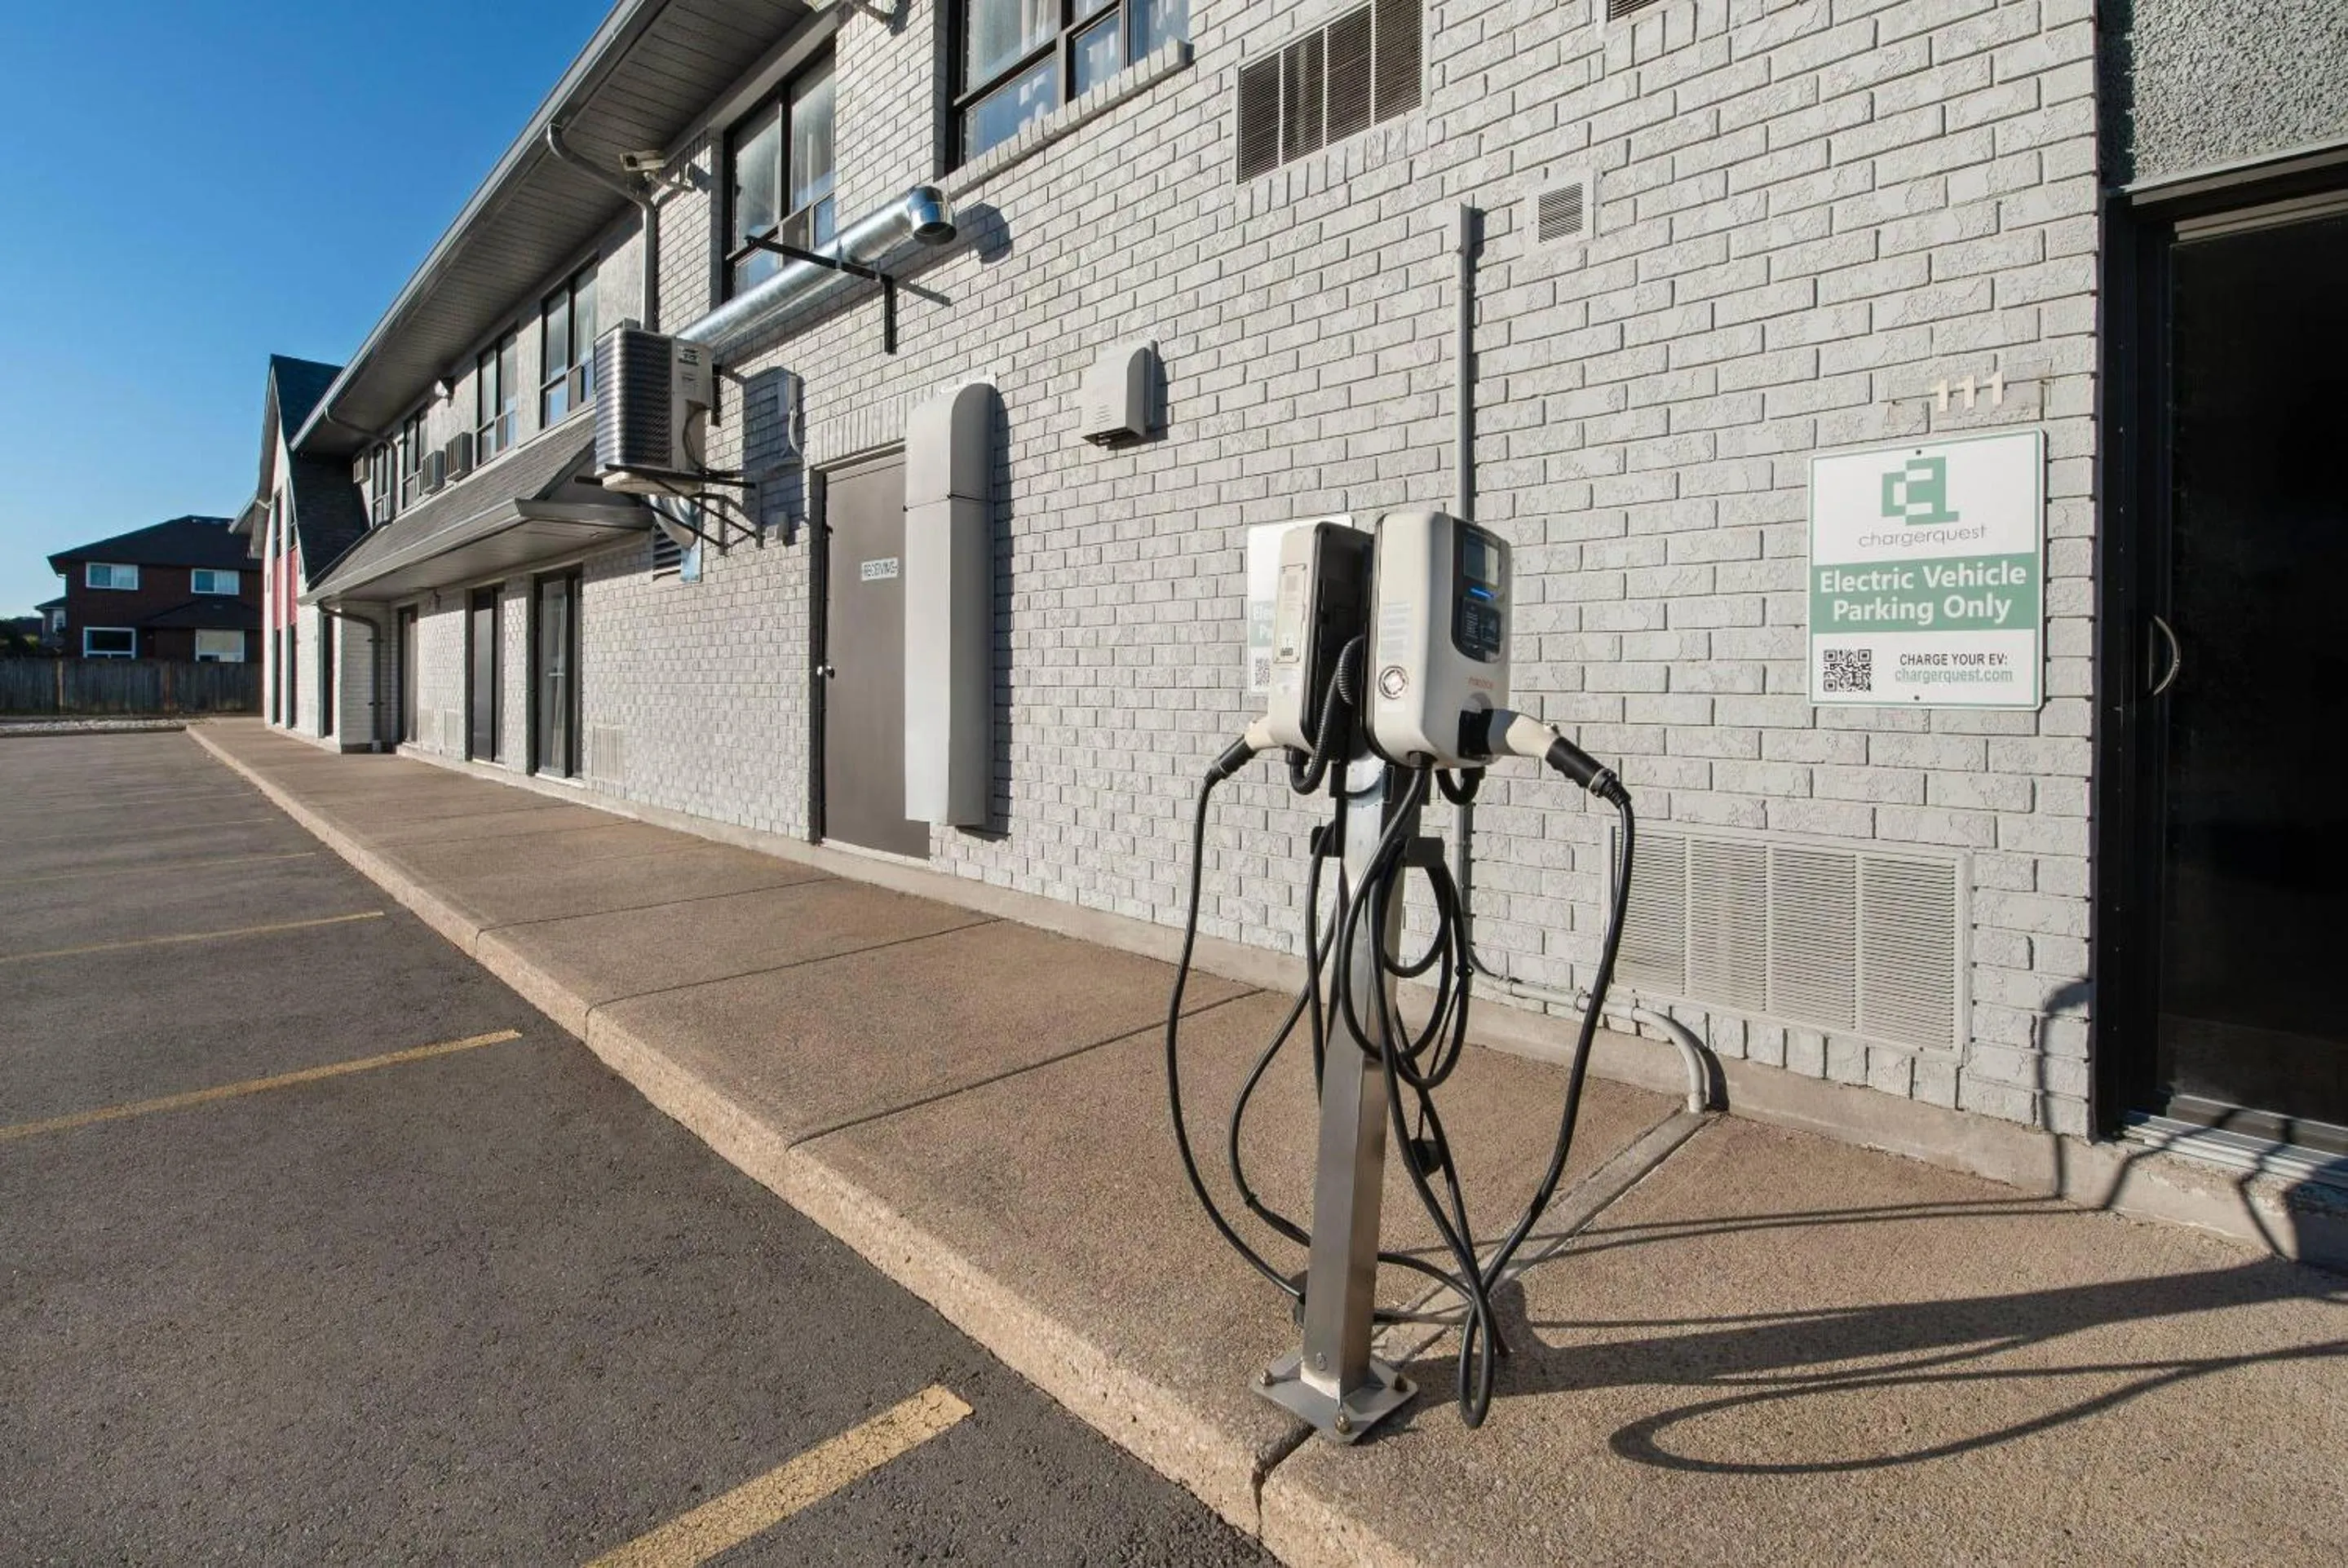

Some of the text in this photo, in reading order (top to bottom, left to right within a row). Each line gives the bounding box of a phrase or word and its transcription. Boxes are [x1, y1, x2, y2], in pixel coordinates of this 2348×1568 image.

[1930, 371, 2003, 412] 111
[1859, 524, 1987, 547] chargerquest
[1820, 560, 2027, 594] Electric Vehicle
[1833, 593, 2013, 625] Parking Only
[1899, 653, 2009, 666] CHARGE YOUR EV:
[1895, 668, 2014, 684] chargerquest.com
